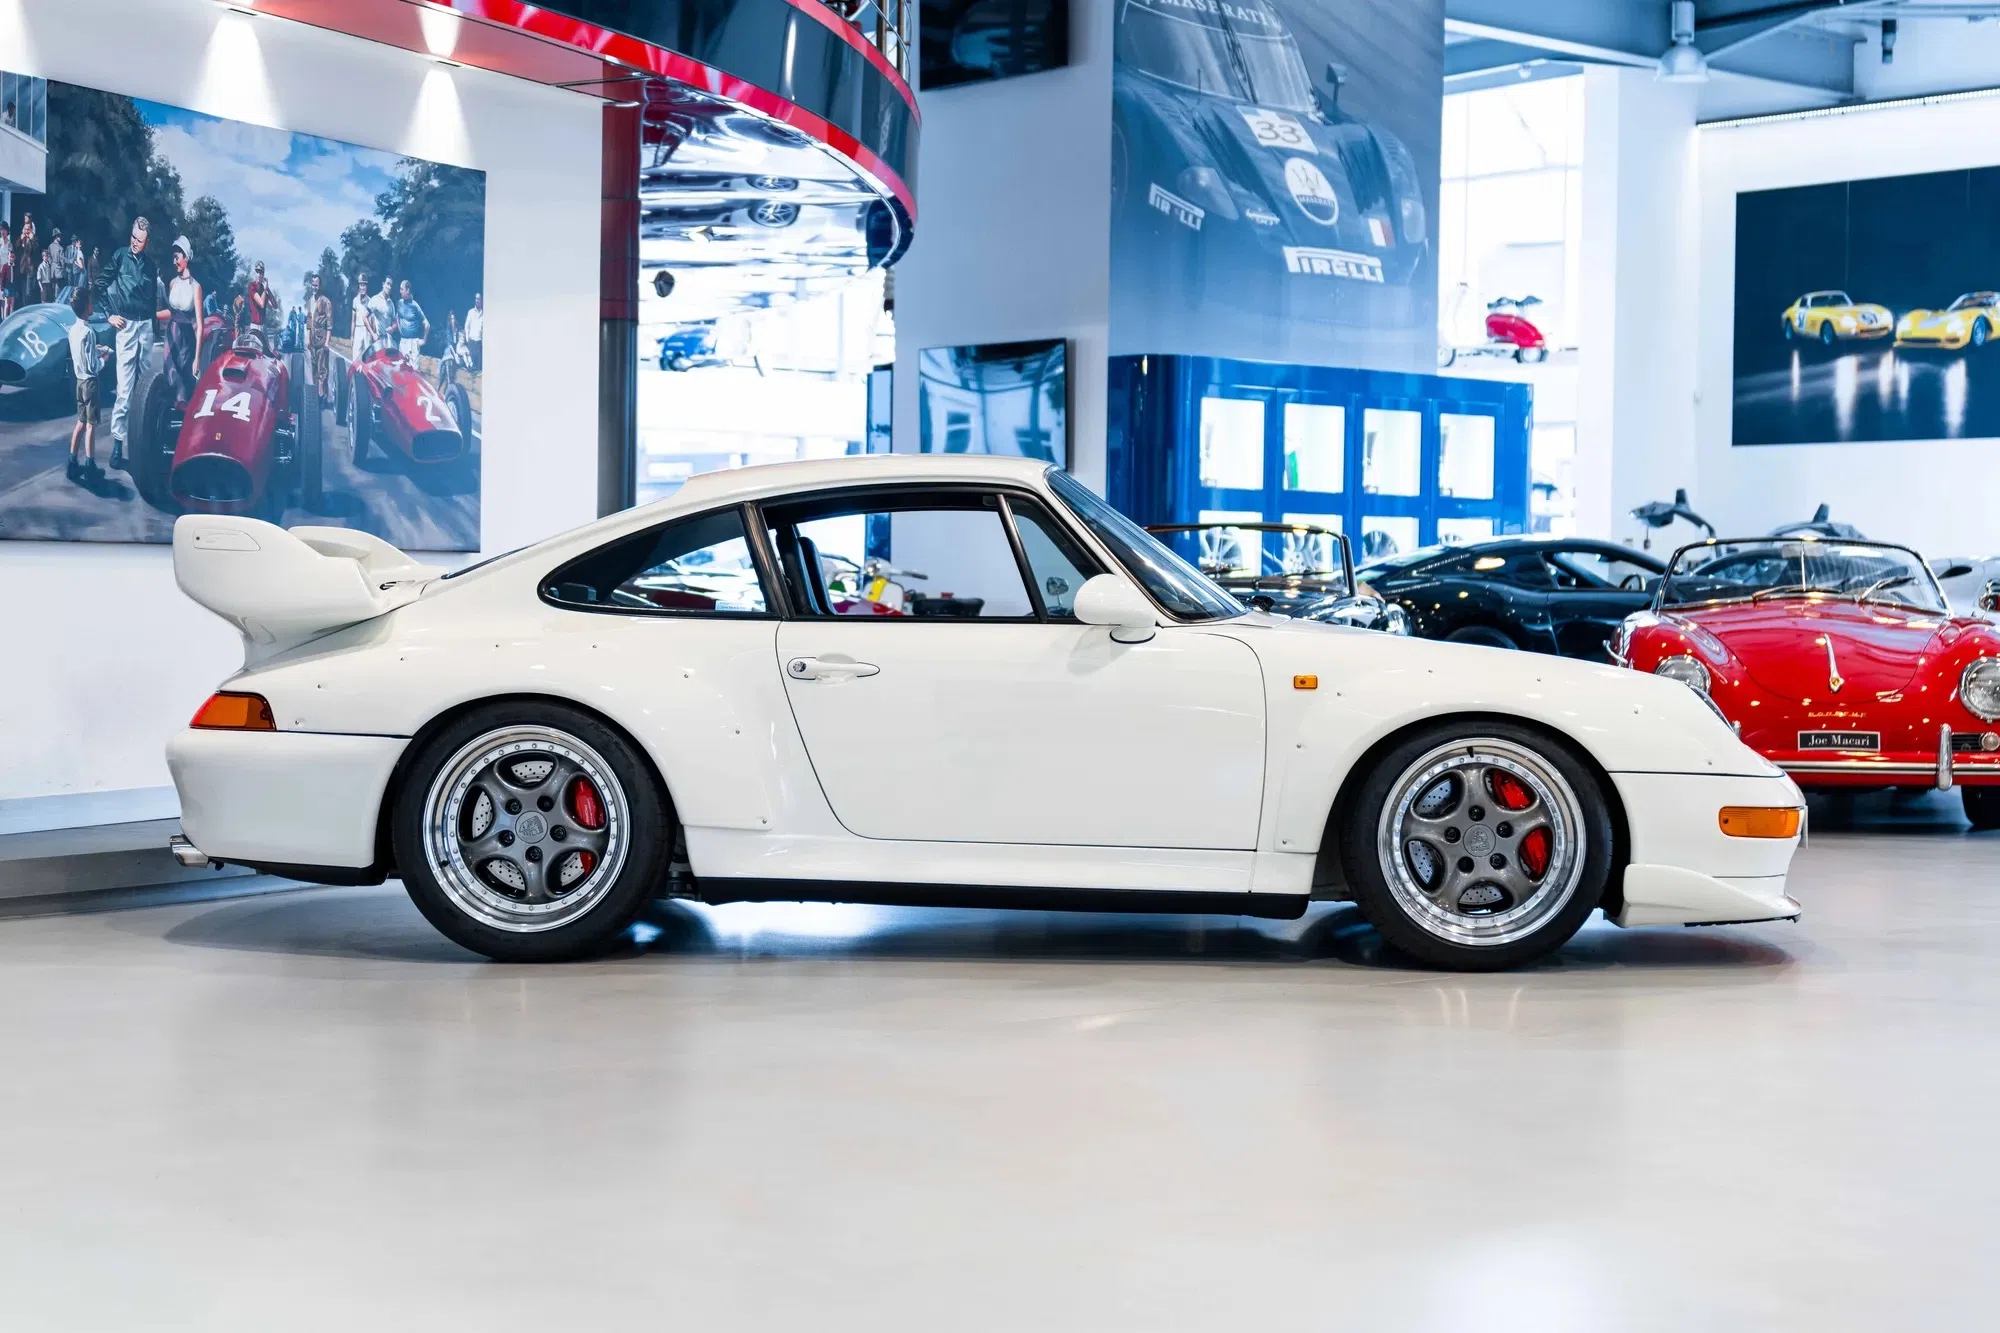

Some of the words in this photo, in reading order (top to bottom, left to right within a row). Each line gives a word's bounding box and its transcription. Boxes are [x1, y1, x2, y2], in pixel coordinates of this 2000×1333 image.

[1256, 120, 1301, 144] 33
[1149, 182, 1205, 231] PIRLLI
[1282, 245, 1384, 283] PIRELLI
[17, 330, 49, 359] 18
[193, 389, 251, 422] 14
[417, 395, 442, 422] 2
[1808, 734, 1828, 746] Joe
[1831, 734, 1870, 746] Macari
